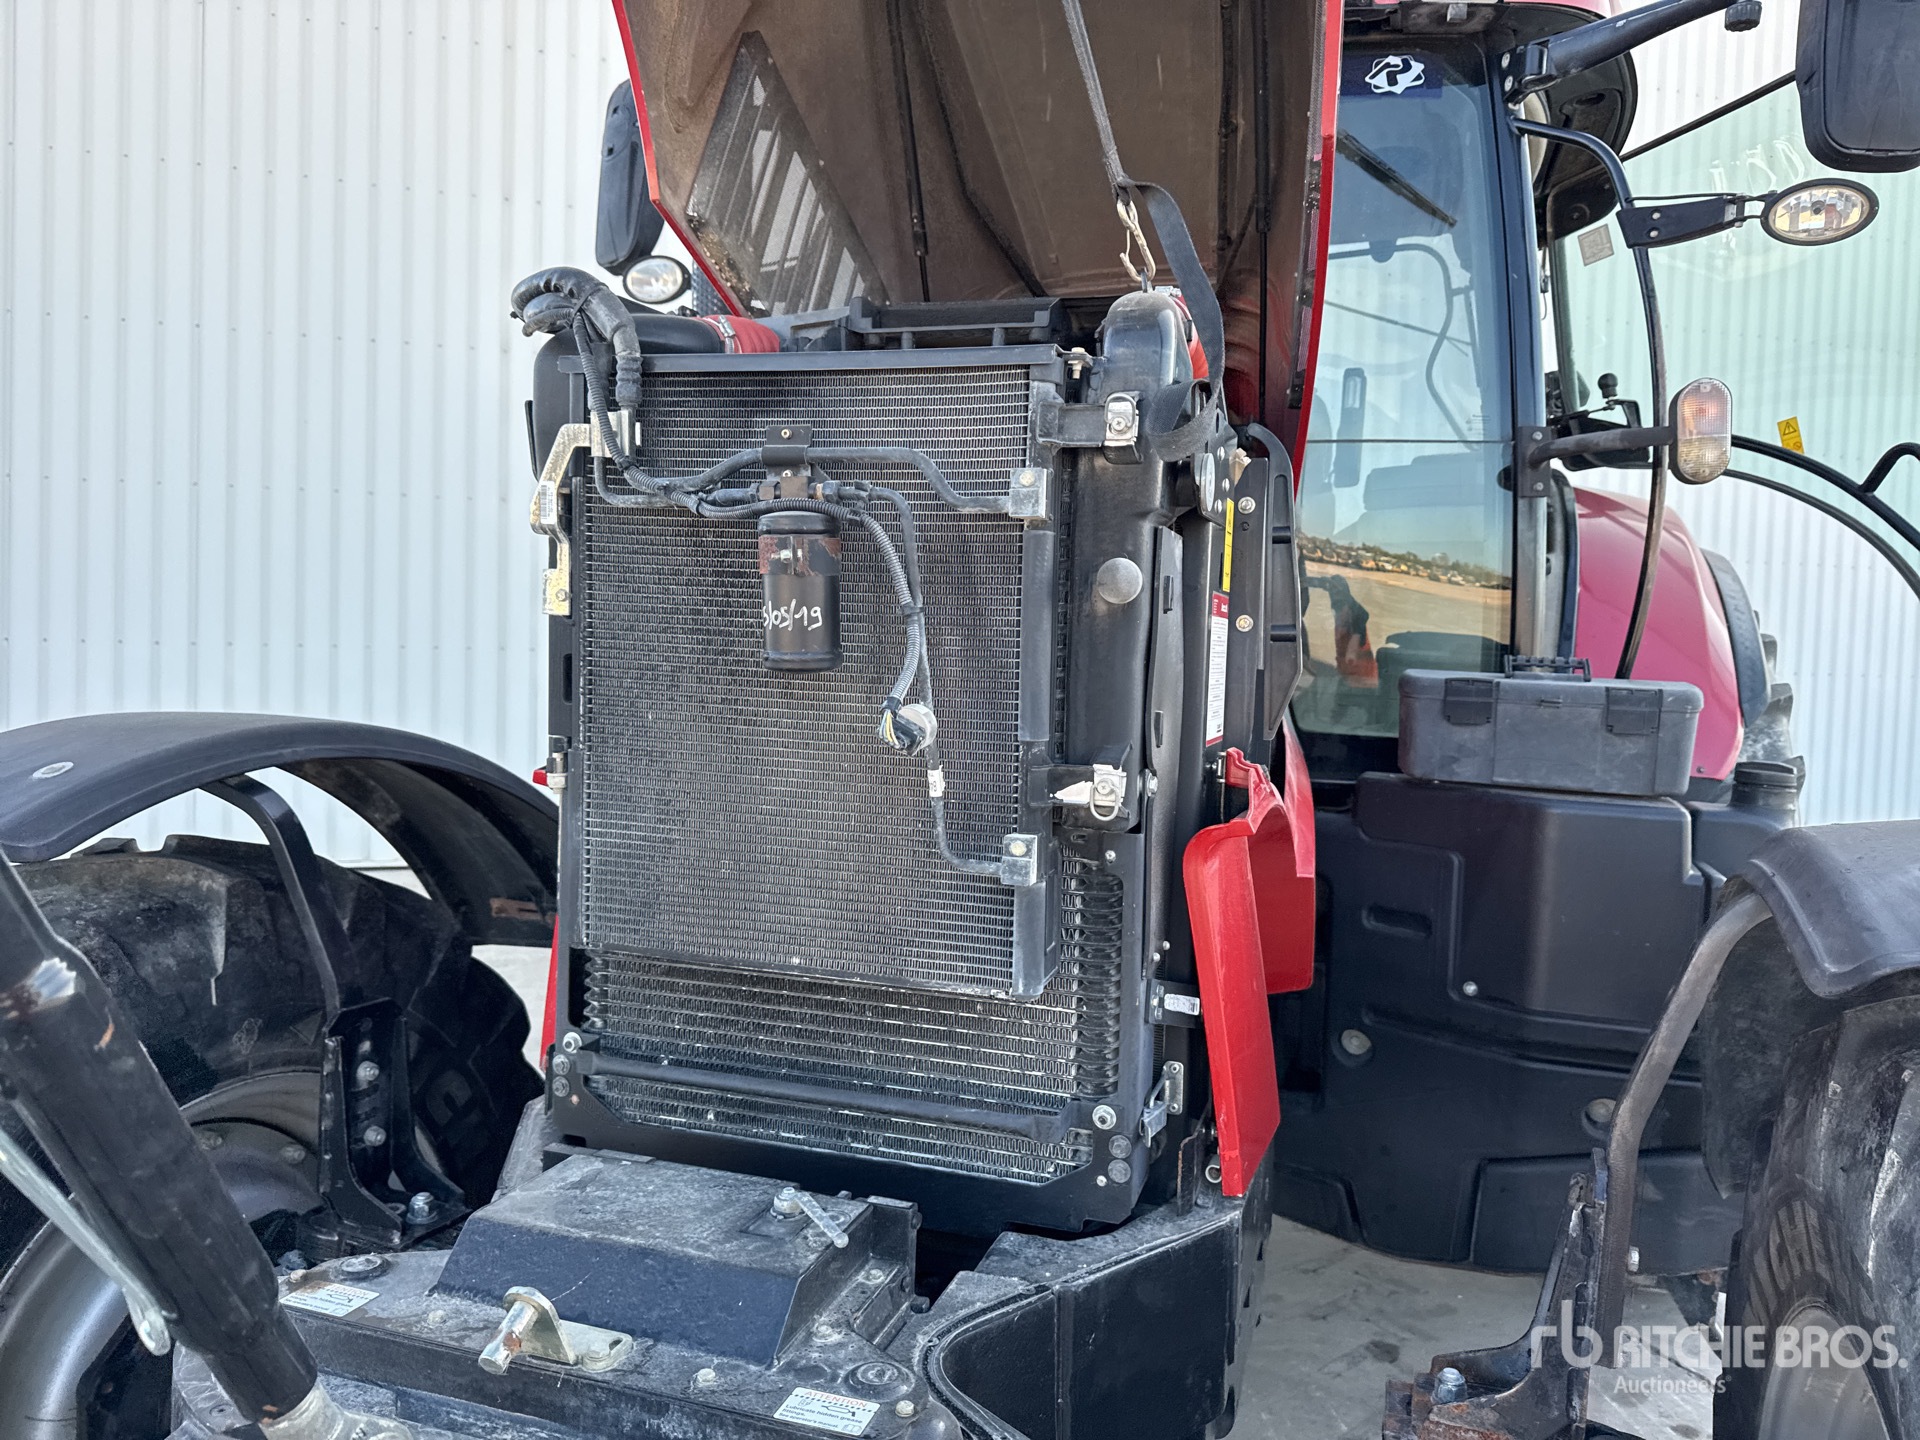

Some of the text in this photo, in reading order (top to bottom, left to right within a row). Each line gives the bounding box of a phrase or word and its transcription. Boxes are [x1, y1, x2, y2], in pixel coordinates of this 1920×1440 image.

[804, 1391, 868, 1408] ATTENTION
[785, 1404, 863, 1424] Lubricate hidden grease
